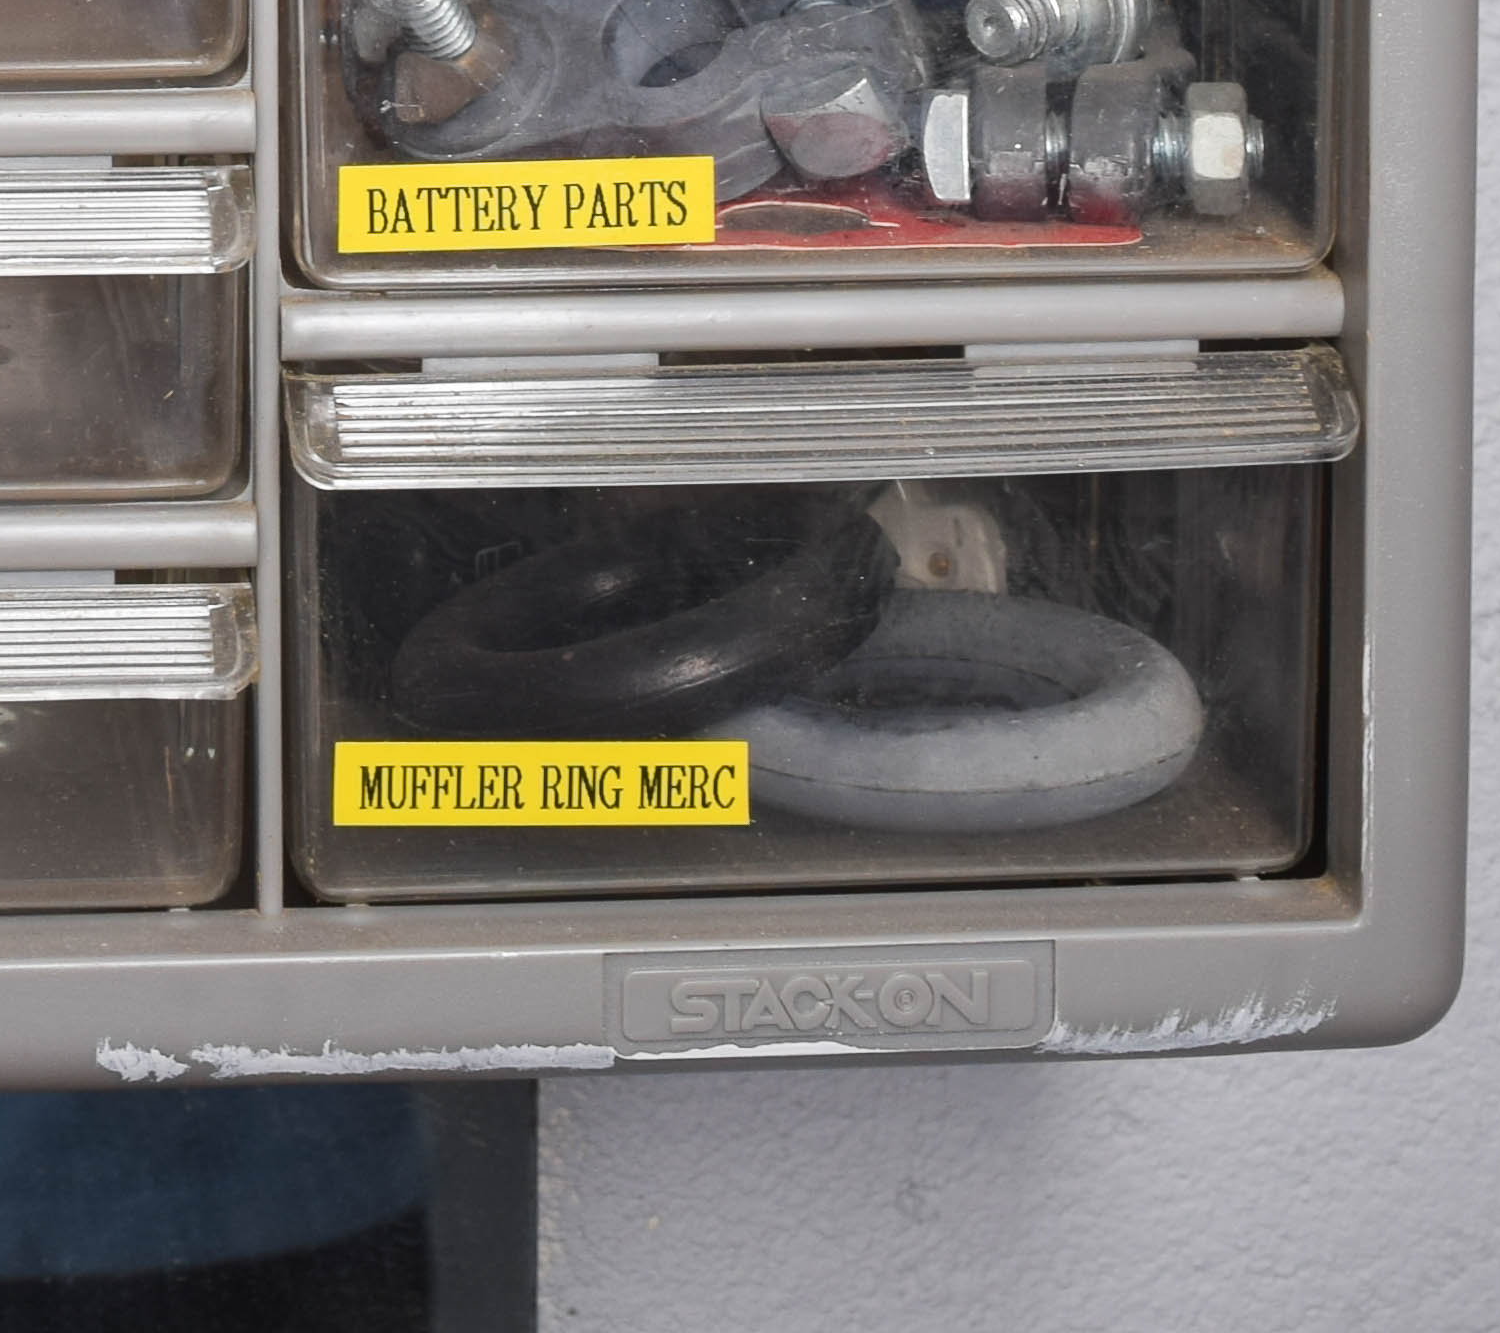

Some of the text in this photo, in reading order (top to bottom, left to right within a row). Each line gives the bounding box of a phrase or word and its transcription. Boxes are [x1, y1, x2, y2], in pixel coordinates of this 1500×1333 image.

[367, 181, 687, 234] BATTERY PARTS
[360, 765, 735, 809] MUFFLER RING MERC
[667, 969, 991, 1035] STACK-ON
